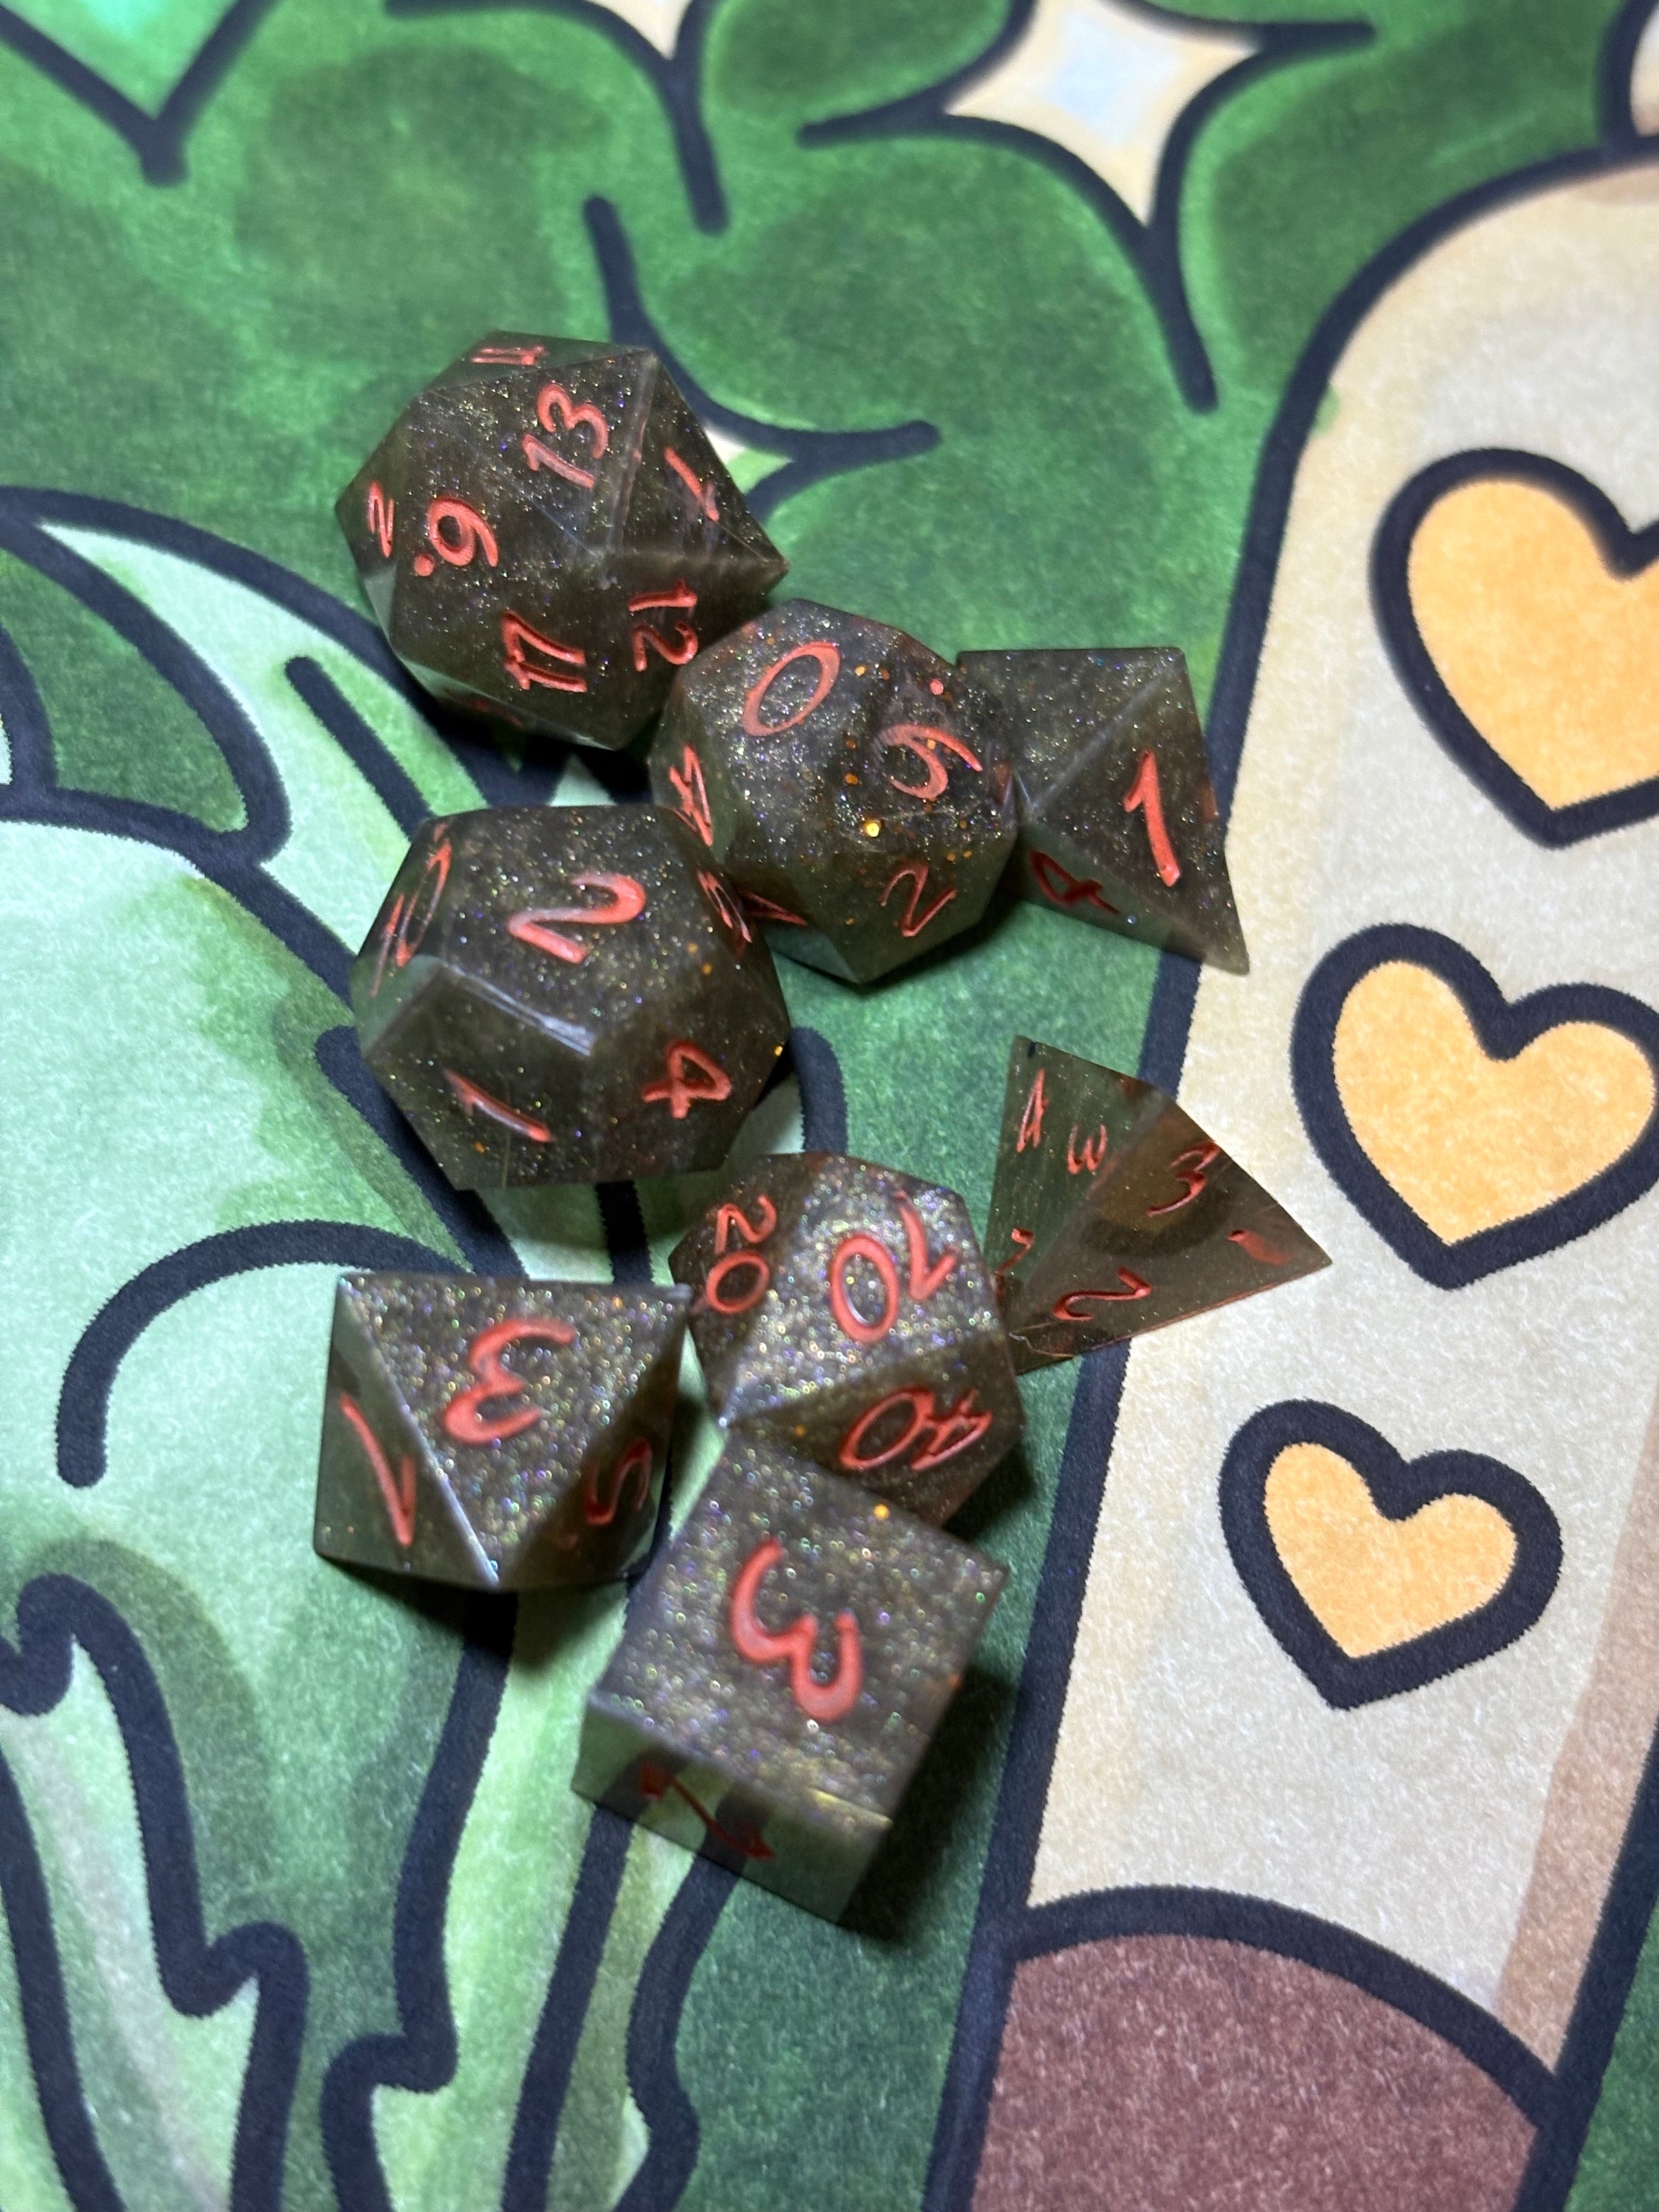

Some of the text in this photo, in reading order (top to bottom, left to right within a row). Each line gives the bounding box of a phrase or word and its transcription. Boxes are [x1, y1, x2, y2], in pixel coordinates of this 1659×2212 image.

[522, 382, 609, 489] 13
[503, 610, 587, 694] 17
[628, 580, 699, 673] 12
[742, 641, 840, 737] 0
[1124, 749, 1181, 888] 1
[507, 873, 647, 966] 2
[641, 1040, 734, 1120] 4
[1147, 1139, 1221, 1218] 3
[706, 1194, 778, 1314] 20
[827, 1189, 961, 1347] 70
[443, 1316, 578, 1446] 3
[838, 1385, 992, 1472] 40
[730, 1536, 864, 1724] 3
